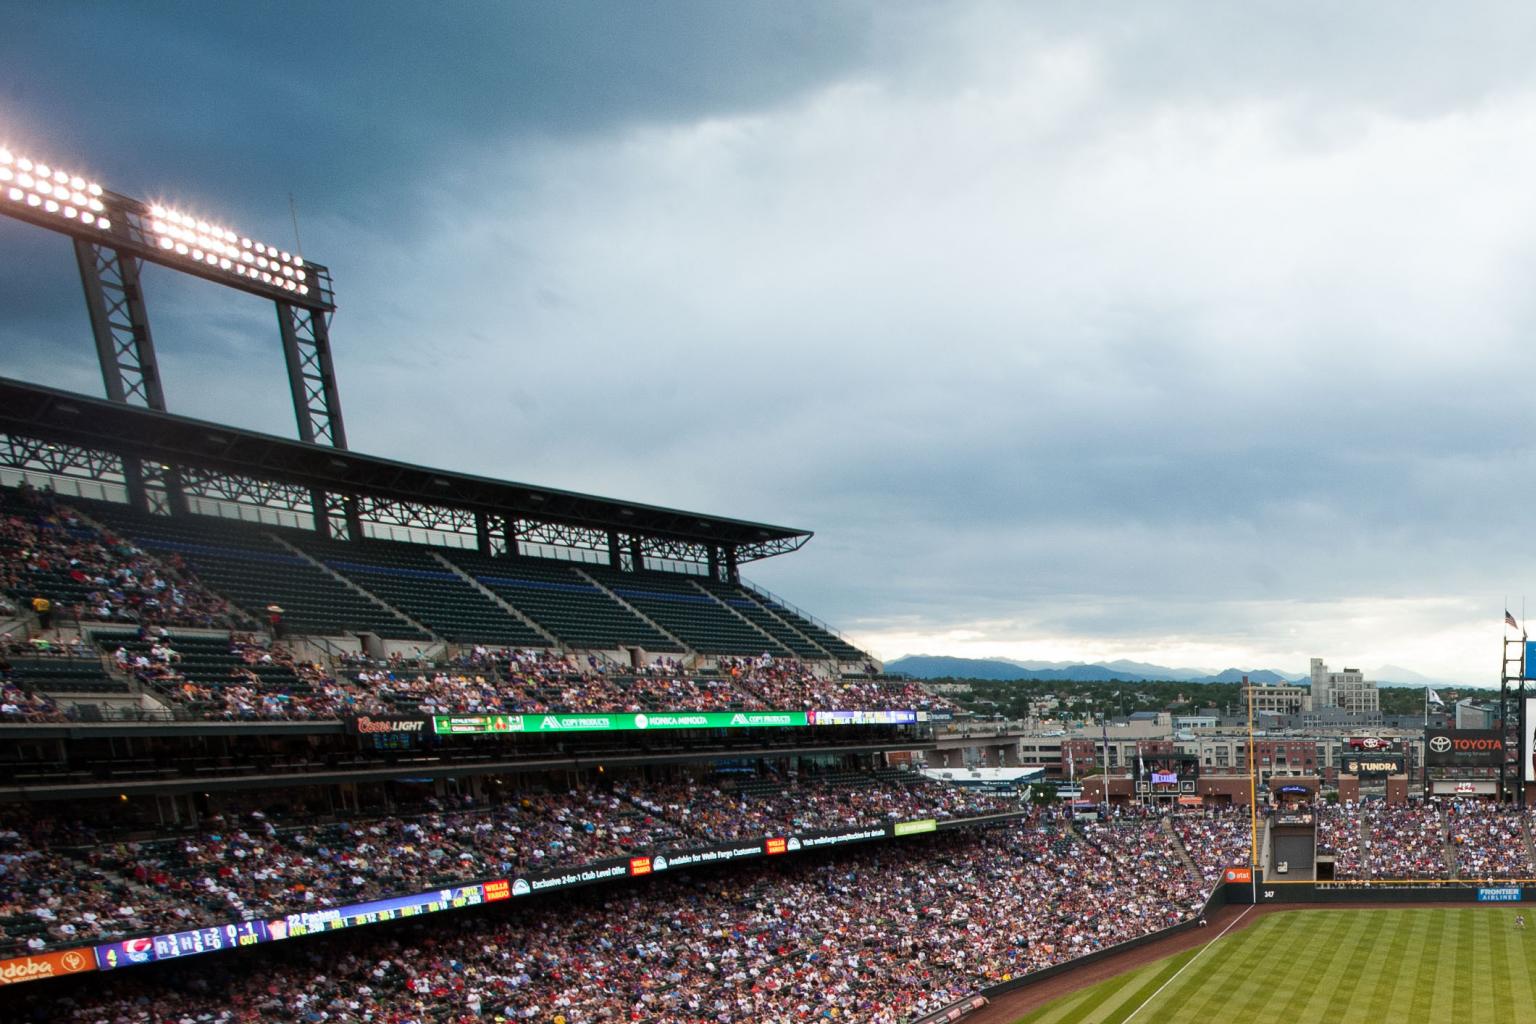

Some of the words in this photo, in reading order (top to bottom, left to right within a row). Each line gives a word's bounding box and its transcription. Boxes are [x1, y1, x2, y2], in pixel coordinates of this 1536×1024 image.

[393, 720, 425, 732] LIGHT
[1453, 739, 1502, 750] TOYOTA
[1361, 762, 1398, 771] TUNDRA
[693, 852, 701, 862] for
[702, 850, 717, 861] Wells
[718, 849, 733, 860] Fargo
[733, 846, 761, 858] Customers
[632, 859, 650, 867] WELLS
[532, 877, 562, 889] Exclusive
[562, 874, 581, 885] 2-for-1
[582, 871, 596, 881] Club
[596, 868, 612, 879] Level
[612, 866, 626, 876] Offer
[485, 882, 508, 891] WELLS
[487, 890, 509, 900] FARGO
[1264, 890, 1275, 898] 347
[168, 934, 177, 946] 3
[192, 931, 201, 942] 3
[226, 921, 254, 937] 0-1
[239, 933, 258, 945] OUT
[157, 941, 168, 954] R
[180, 937, 192, 950] H
[205, 934, 213, 947] E
[106, 949, 117, 961] 4
